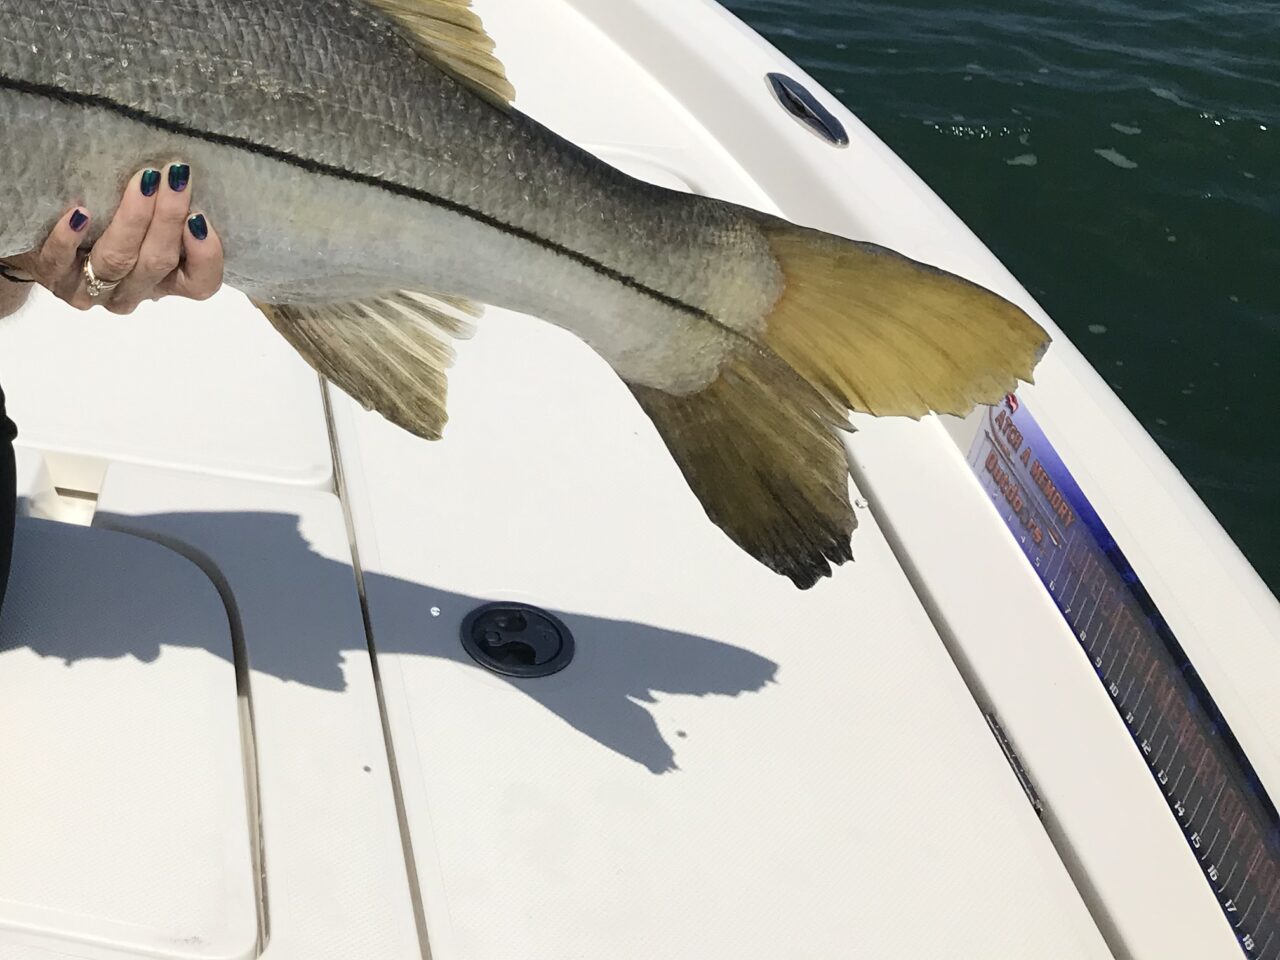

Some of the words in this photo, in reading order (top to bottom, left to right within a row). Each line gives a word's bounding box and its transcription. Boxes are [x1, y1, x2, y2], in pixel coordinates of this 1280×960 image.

[1029, 458, 1075, 528] MEMORY
[1049, 580, 1056, 591] 6
[1064, 605, 1072, 614] 7
[1079, 630, 1087, 641] 8
[1094, 656, 1103, 668] 9
[1109, 682, 1119, 697] 10
[1125, 712, 1134, 724] 11
[1141, 739, 1152, 755] 12
[1157, 769, 1168, 785] 13
[1174, 800, 1185, 817] 14
[1190, 831, 1200, 849] 15
[1207, 864, 1219, 881] 16
[1224, 899, 1237, 912] 17
[1242, 933, 1255, 951] 18
